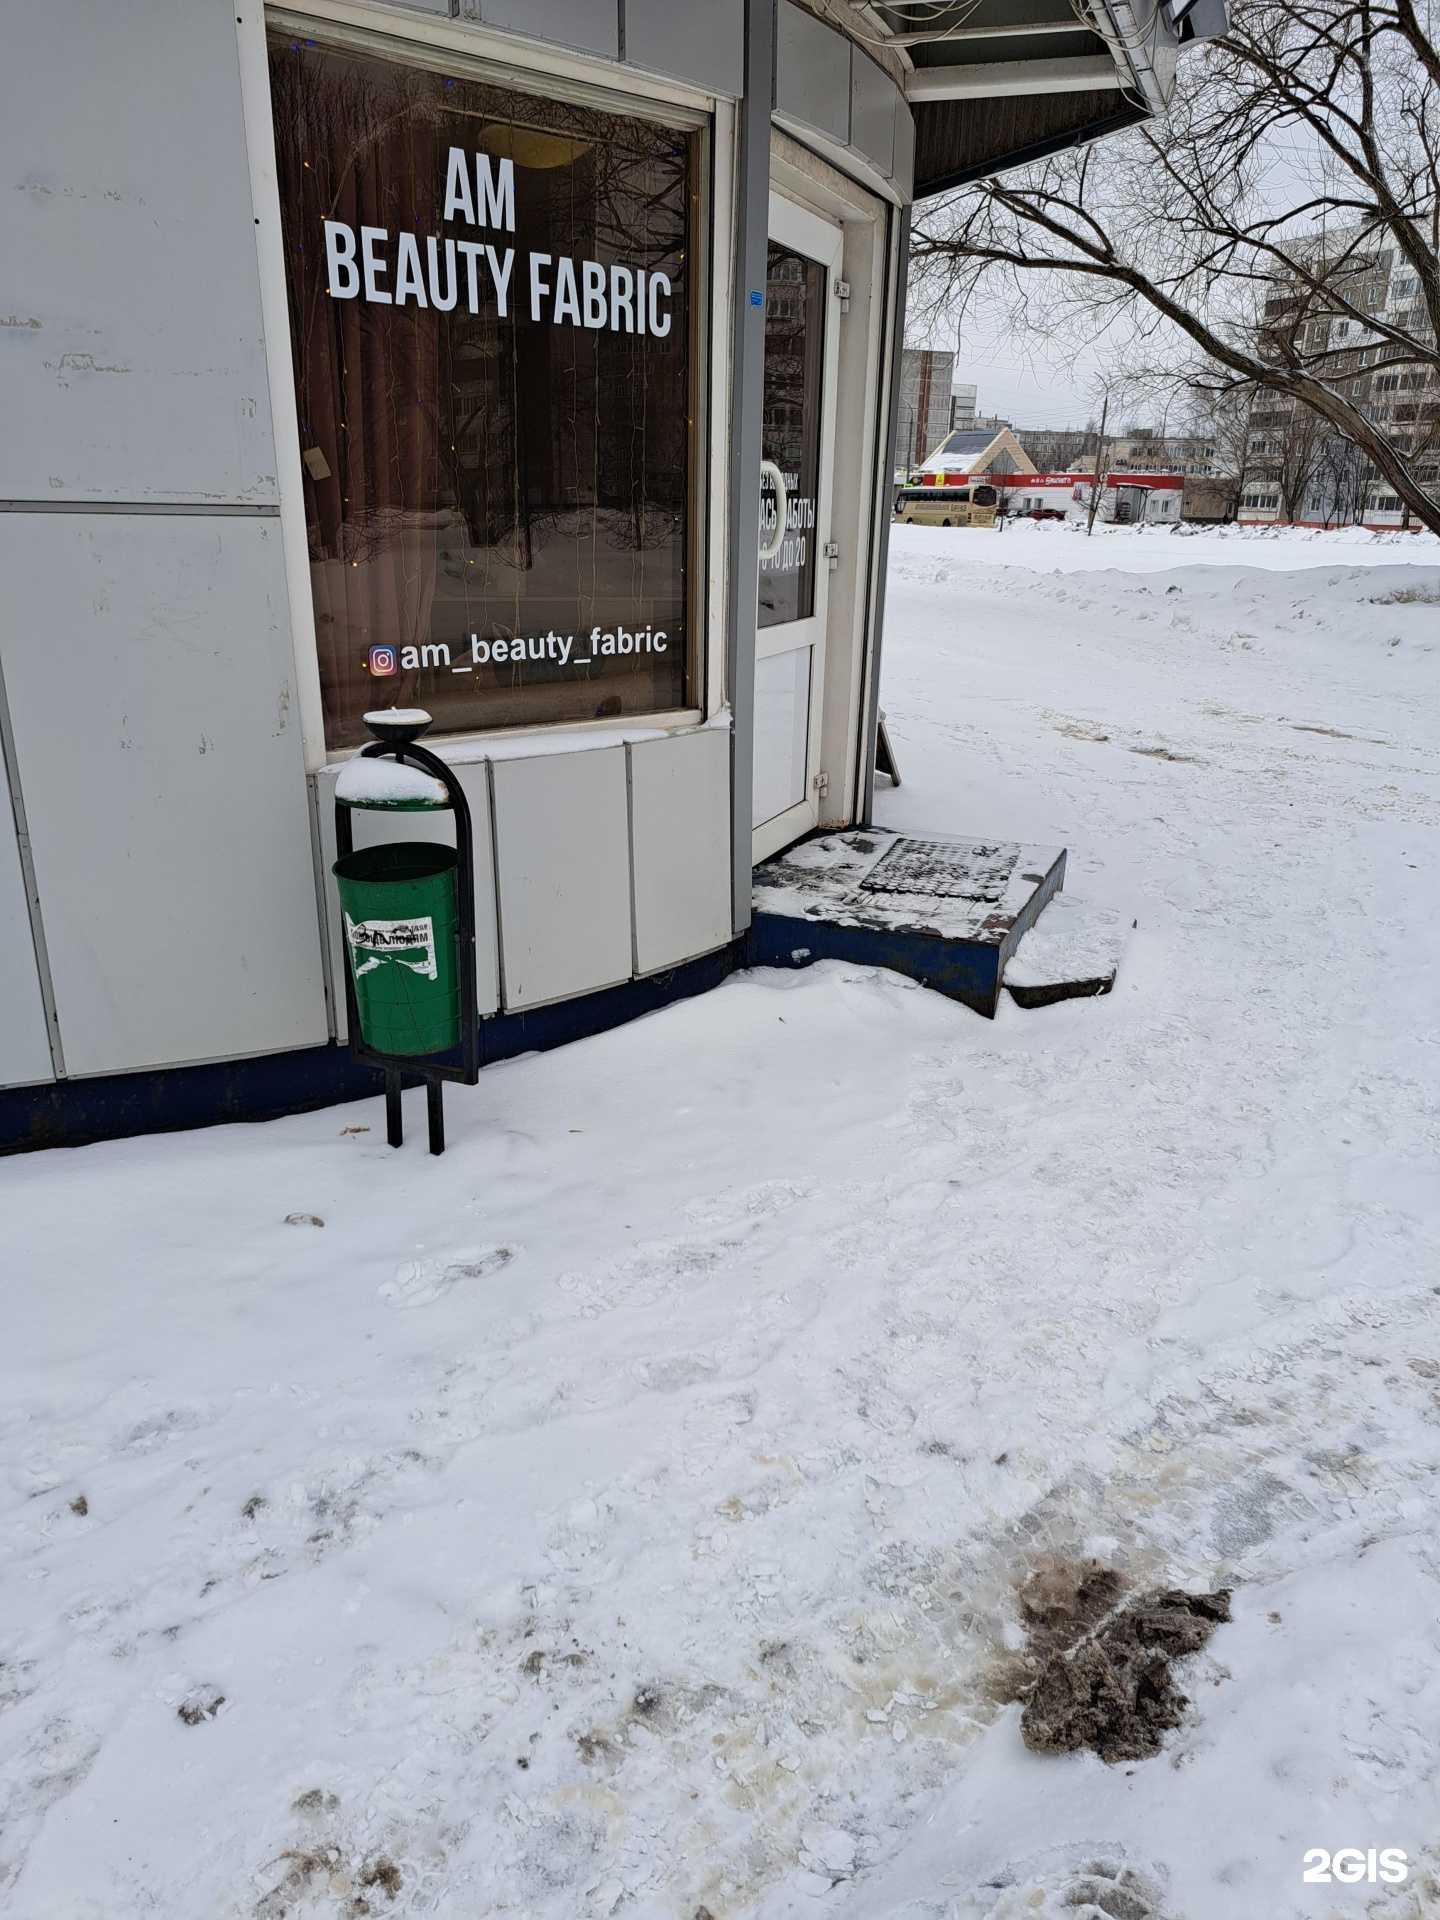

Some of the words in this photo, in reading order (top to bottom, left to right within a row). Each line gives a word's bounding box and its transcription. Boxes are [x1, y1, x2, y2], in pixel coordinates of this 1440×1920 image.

[444, 146, 516, 232] AM
[324, 219, 515, 317] BEAUTY
[529, 251, 672, 337] FABRIC
[785, 498, 816, 530] АБОТЫ
[795, 535, 806, 567] 20
[400, 625, 668, 674] am_beauty_fabric
